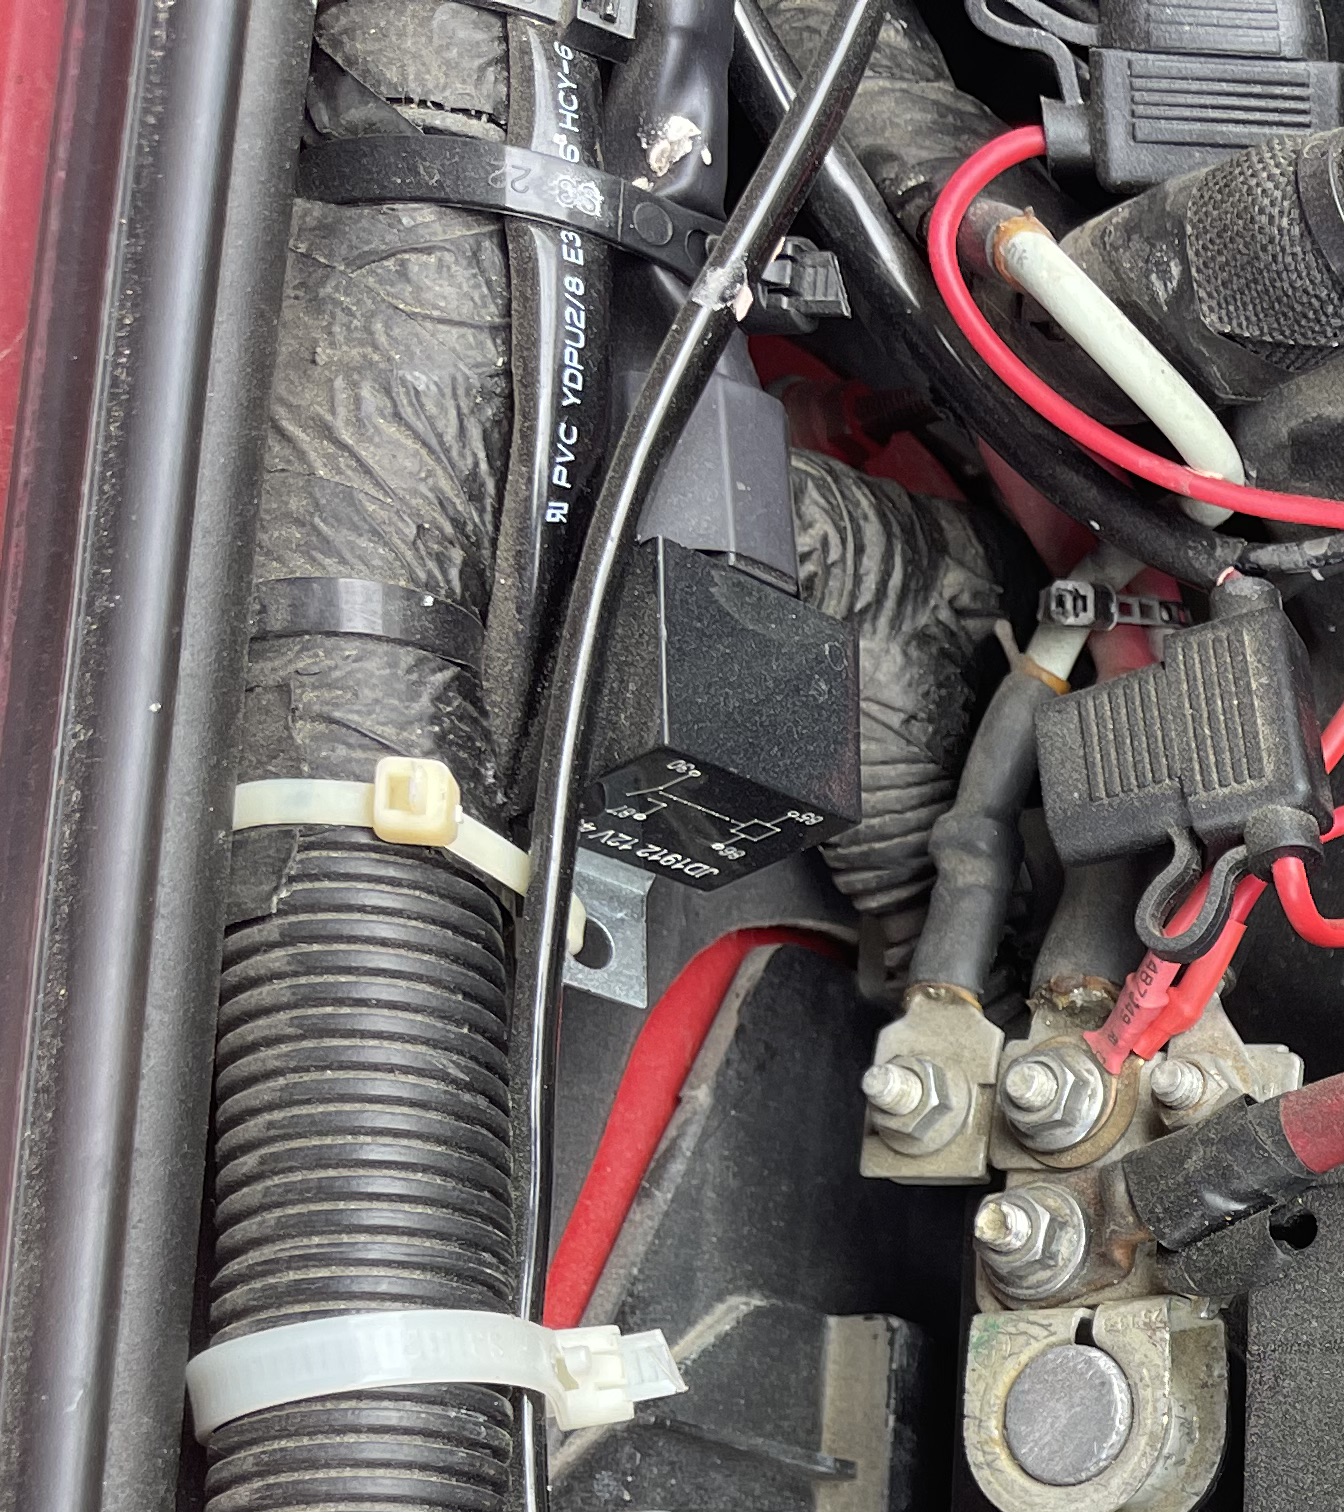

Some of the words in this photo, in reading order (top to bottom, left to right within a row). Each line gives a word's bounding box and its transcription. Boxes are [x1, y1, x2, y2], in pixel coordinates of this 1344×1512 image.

[561, 274, 585, 407] YDPU2/8
[552, 422, 578, 488] PVC
[588, 828, 638, 852] 12V
[636, 843, 719, 879] JD1912
